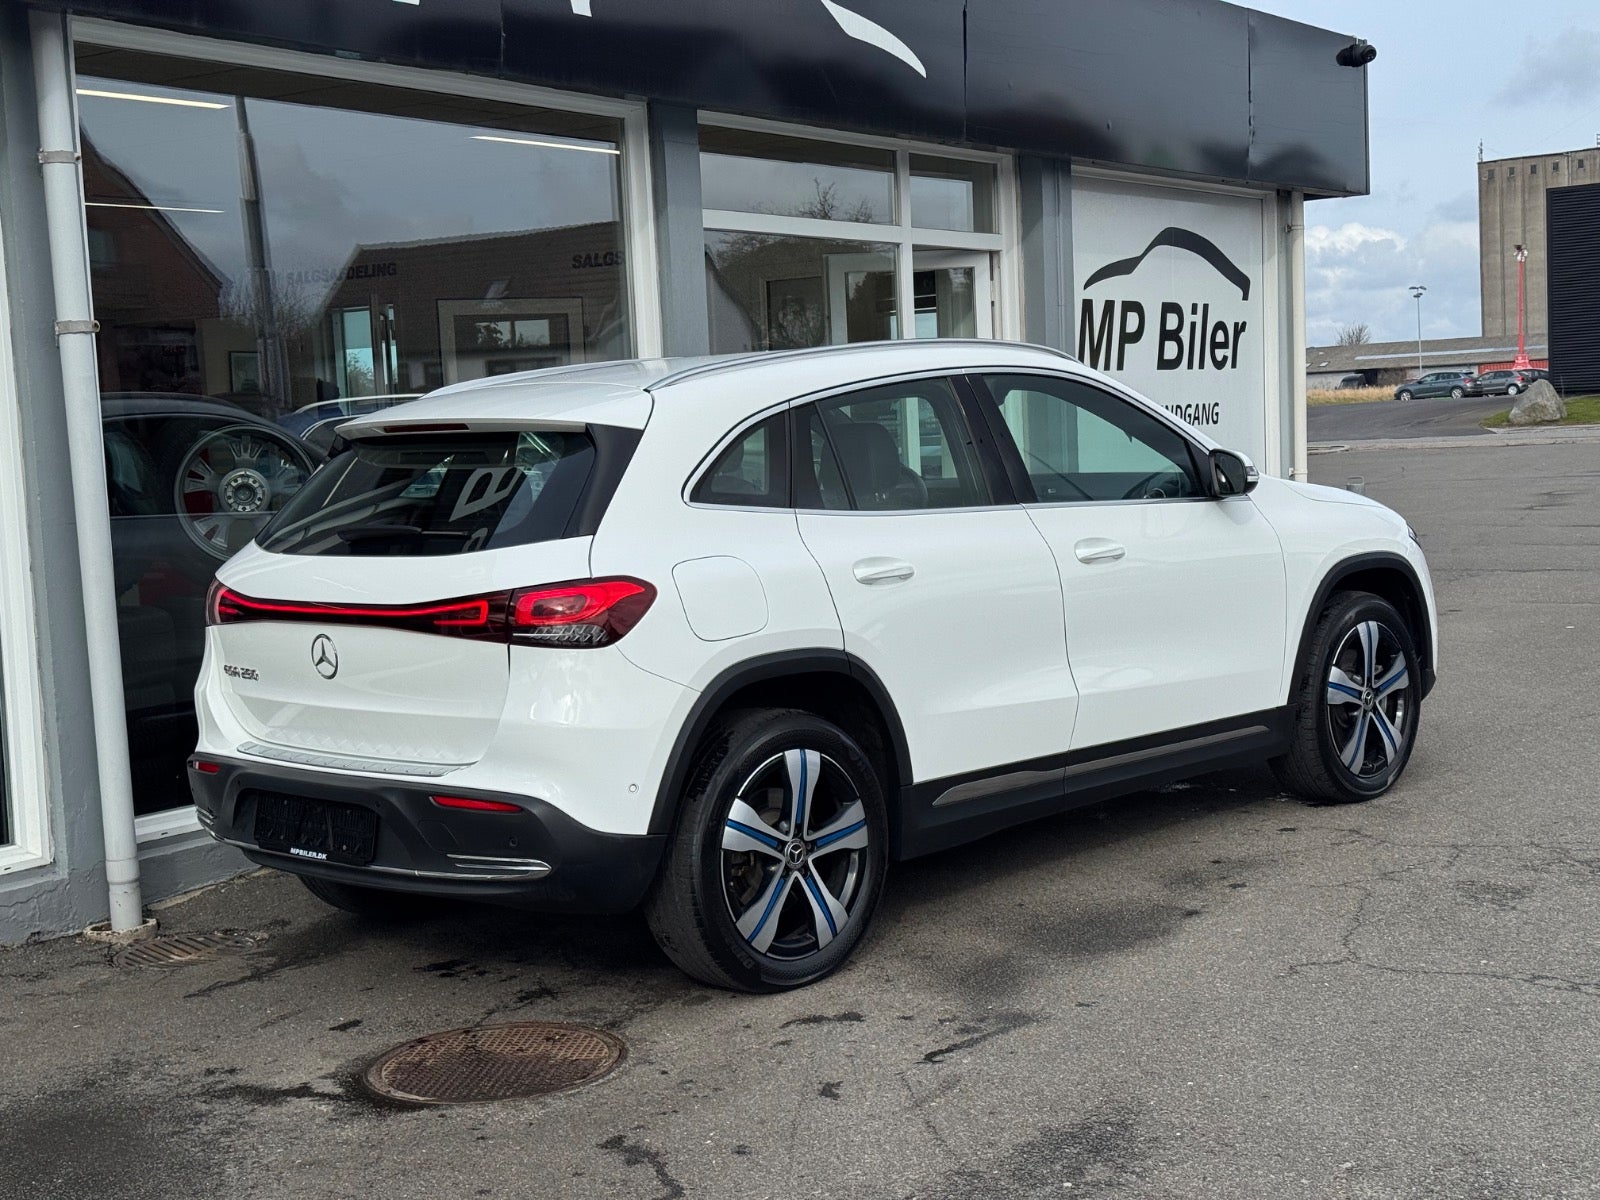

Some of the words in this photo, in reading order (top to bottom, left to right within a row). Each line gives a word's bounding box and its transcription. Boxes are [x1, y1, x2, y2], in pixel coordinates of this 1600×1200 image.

[1078, 298, 1146, 371] MP
[1156, 301, 1247, 371] Biler
[1161, 402, 1220, 426] DGANG
